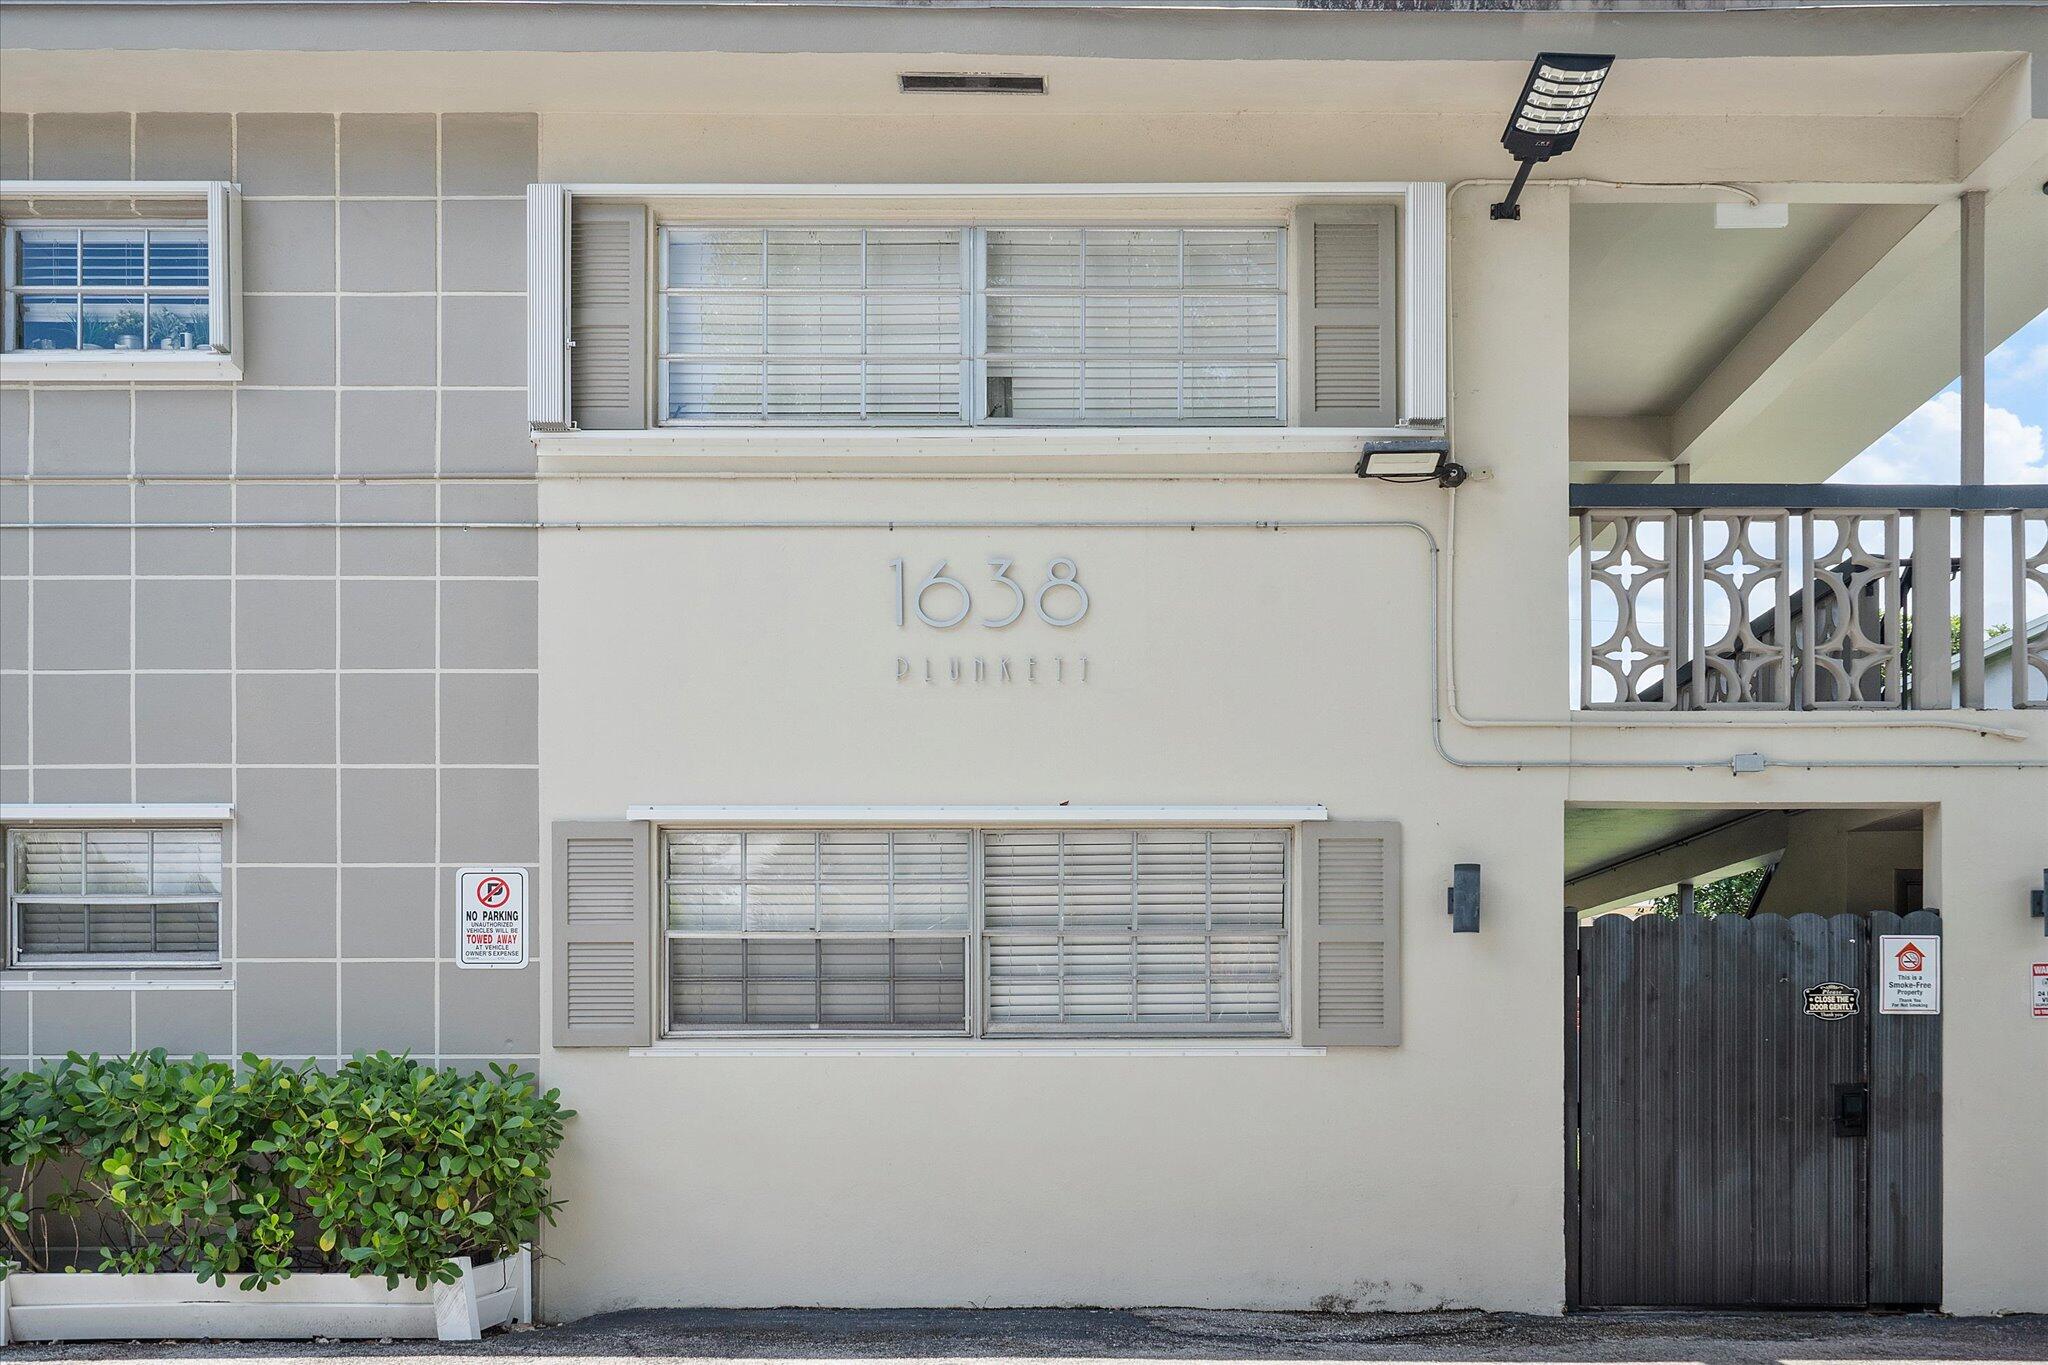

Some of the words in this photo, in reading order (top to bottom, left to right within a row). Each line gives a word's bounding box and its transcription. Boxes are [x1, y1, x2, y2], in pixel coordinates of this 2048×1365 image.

[889, 557, 1089, 628] 1638
[895, 655, 1089, 683] PLUNKETT
[487, 883, 503, 902] P
[466, 911, 478, 921] NO
[482, 911, 519, 921] PARKING
[466, 934, 493, 944] TOWED
[497, 934, 517, 944] AWAY
[1888, 981, 1932, 989] Smoke-Free
